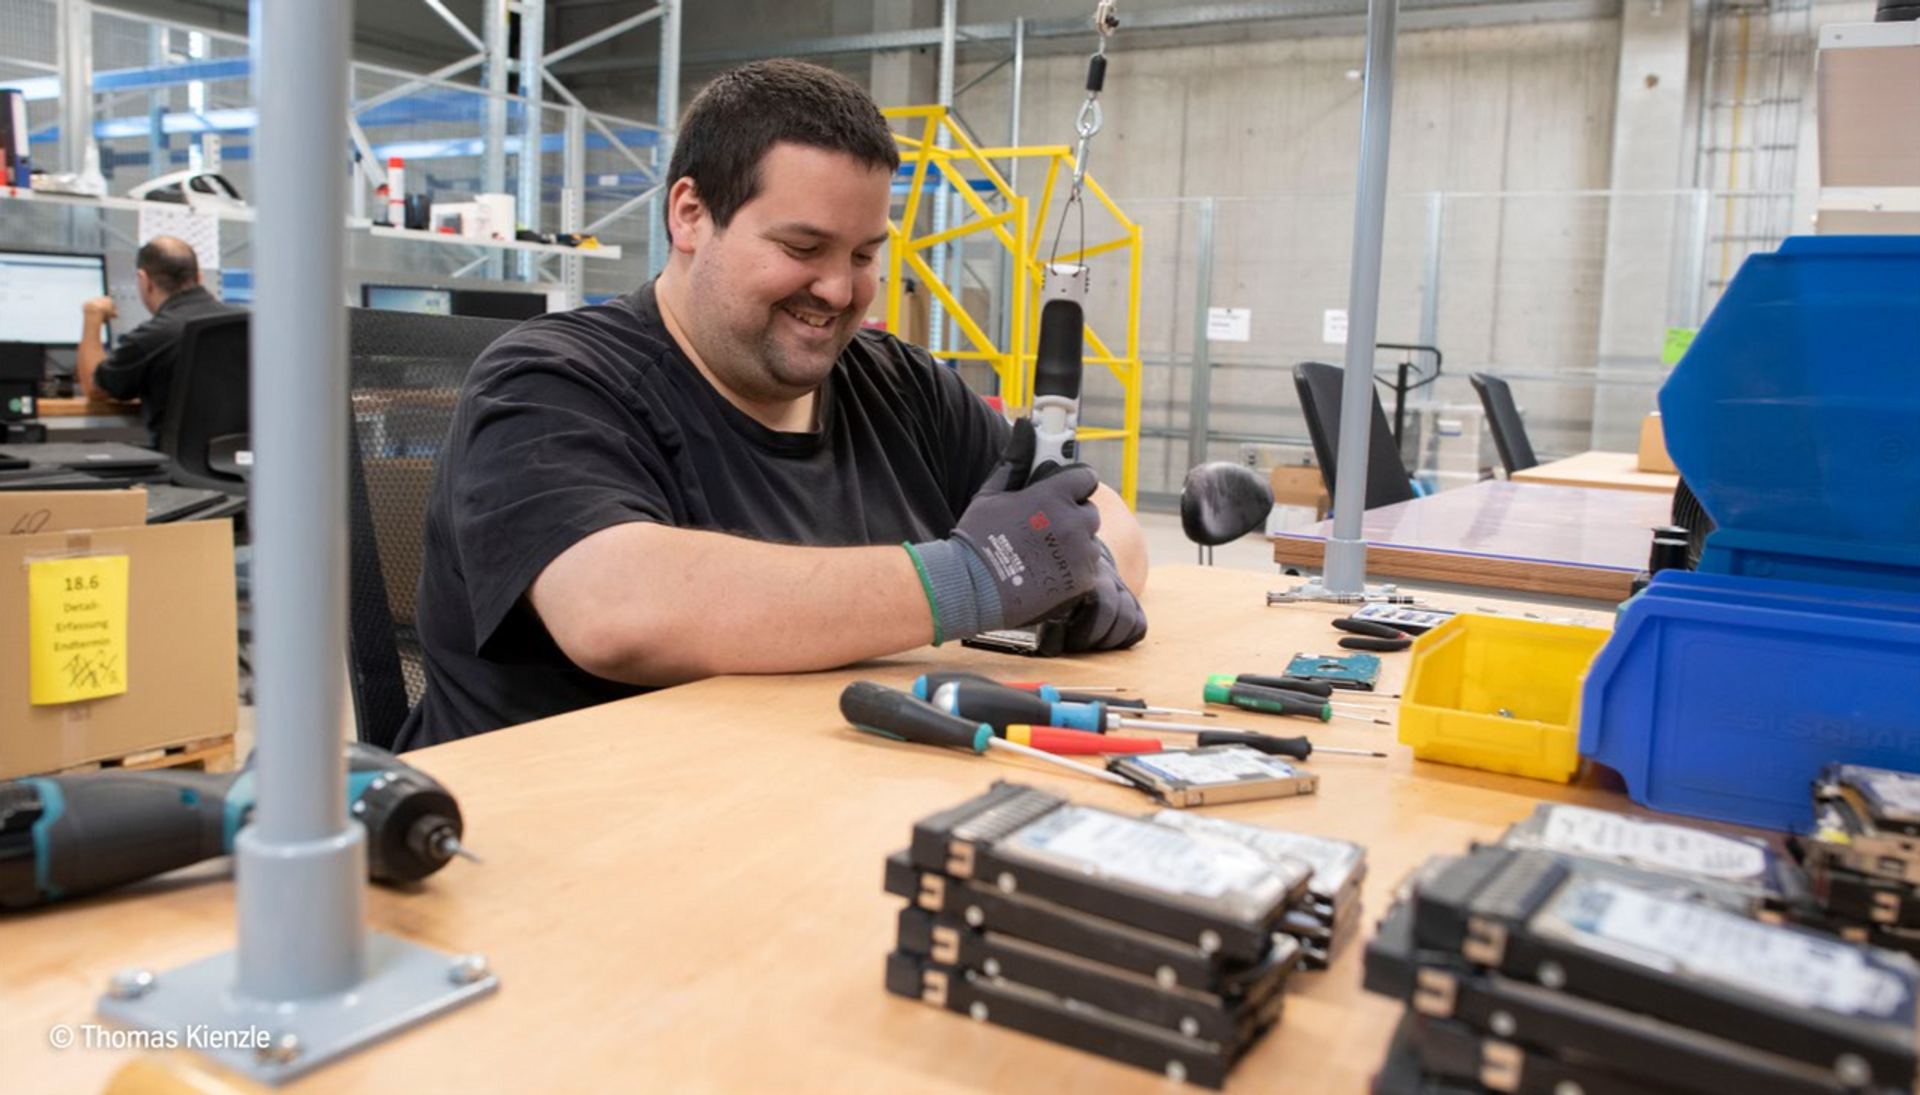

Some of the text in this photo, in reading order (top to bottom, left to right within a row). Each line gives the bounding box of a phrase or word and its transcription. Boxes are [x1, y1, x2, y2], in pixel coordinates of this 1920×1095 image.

[65, 575, 100, 591] 18.6
[56, 620, 109, 633] Erfassung
[54, 638, 111, 652] Endtermin
